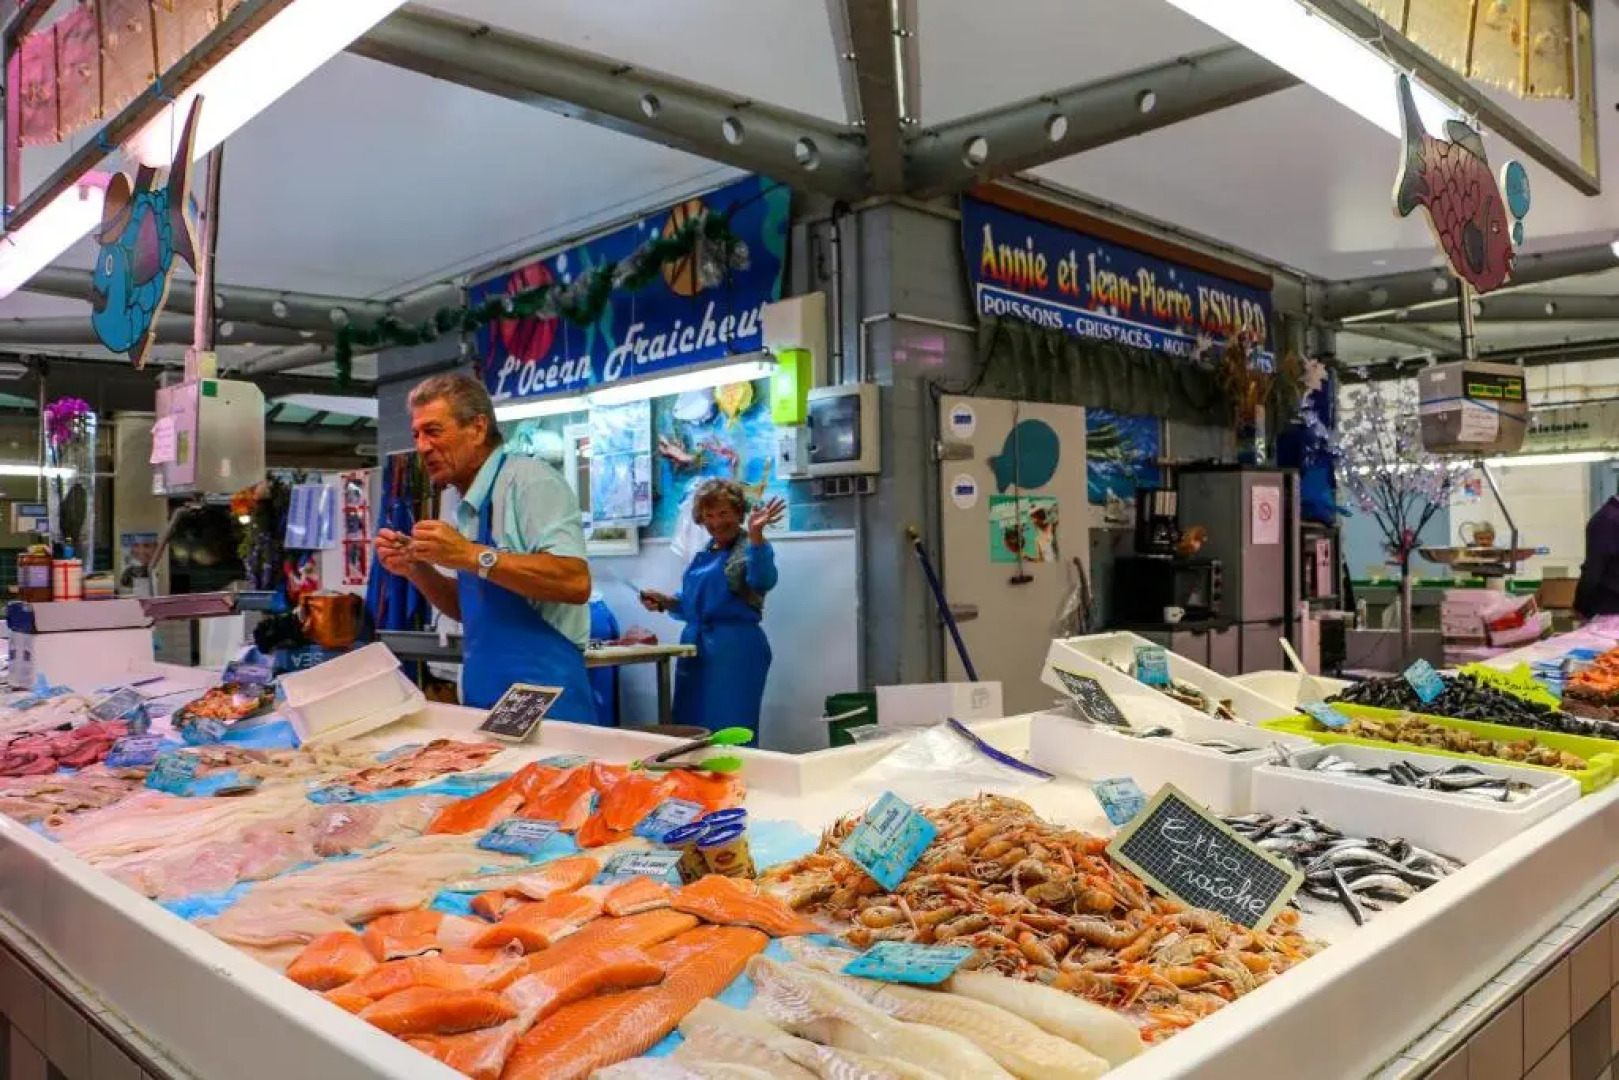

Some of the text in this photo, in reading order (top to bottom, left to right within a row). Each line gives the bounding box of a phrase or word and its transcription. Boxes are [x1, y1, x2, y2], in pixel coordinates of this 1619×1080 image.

[981, 223, 1049, 292] Annie
[1057, 249, 1079, 298] et
[984, 295, 1063, 329] POISSONS
[1076, 317, 1151, 350] CRUSTACÉS
[495, 354, 592, 398] L'Océan
